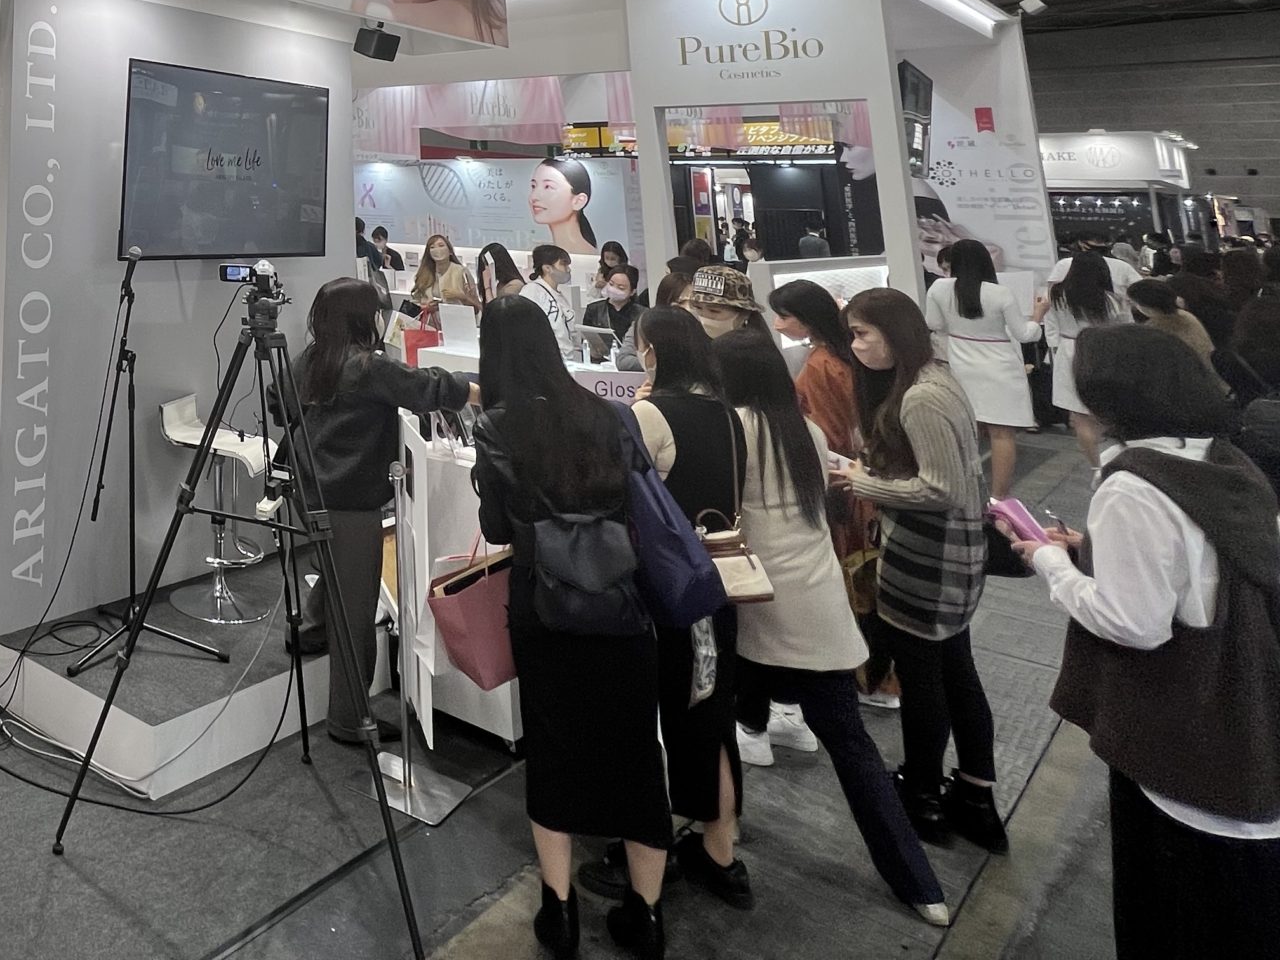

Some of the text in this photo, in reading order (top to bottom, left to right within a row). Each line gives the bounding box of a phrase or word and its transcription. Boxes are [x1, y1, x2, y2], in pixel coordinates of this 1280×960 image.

[676, 27, 824, 66] PureBio
[25, 5, 58, 133] LTD.
[720, 69, 782, 81] Cosmetics
[478, 179, 513, 189] わたしが
[941, 169, 1036, 178] OTHELLO
[11, 290, 51, 587] ARIGATO
